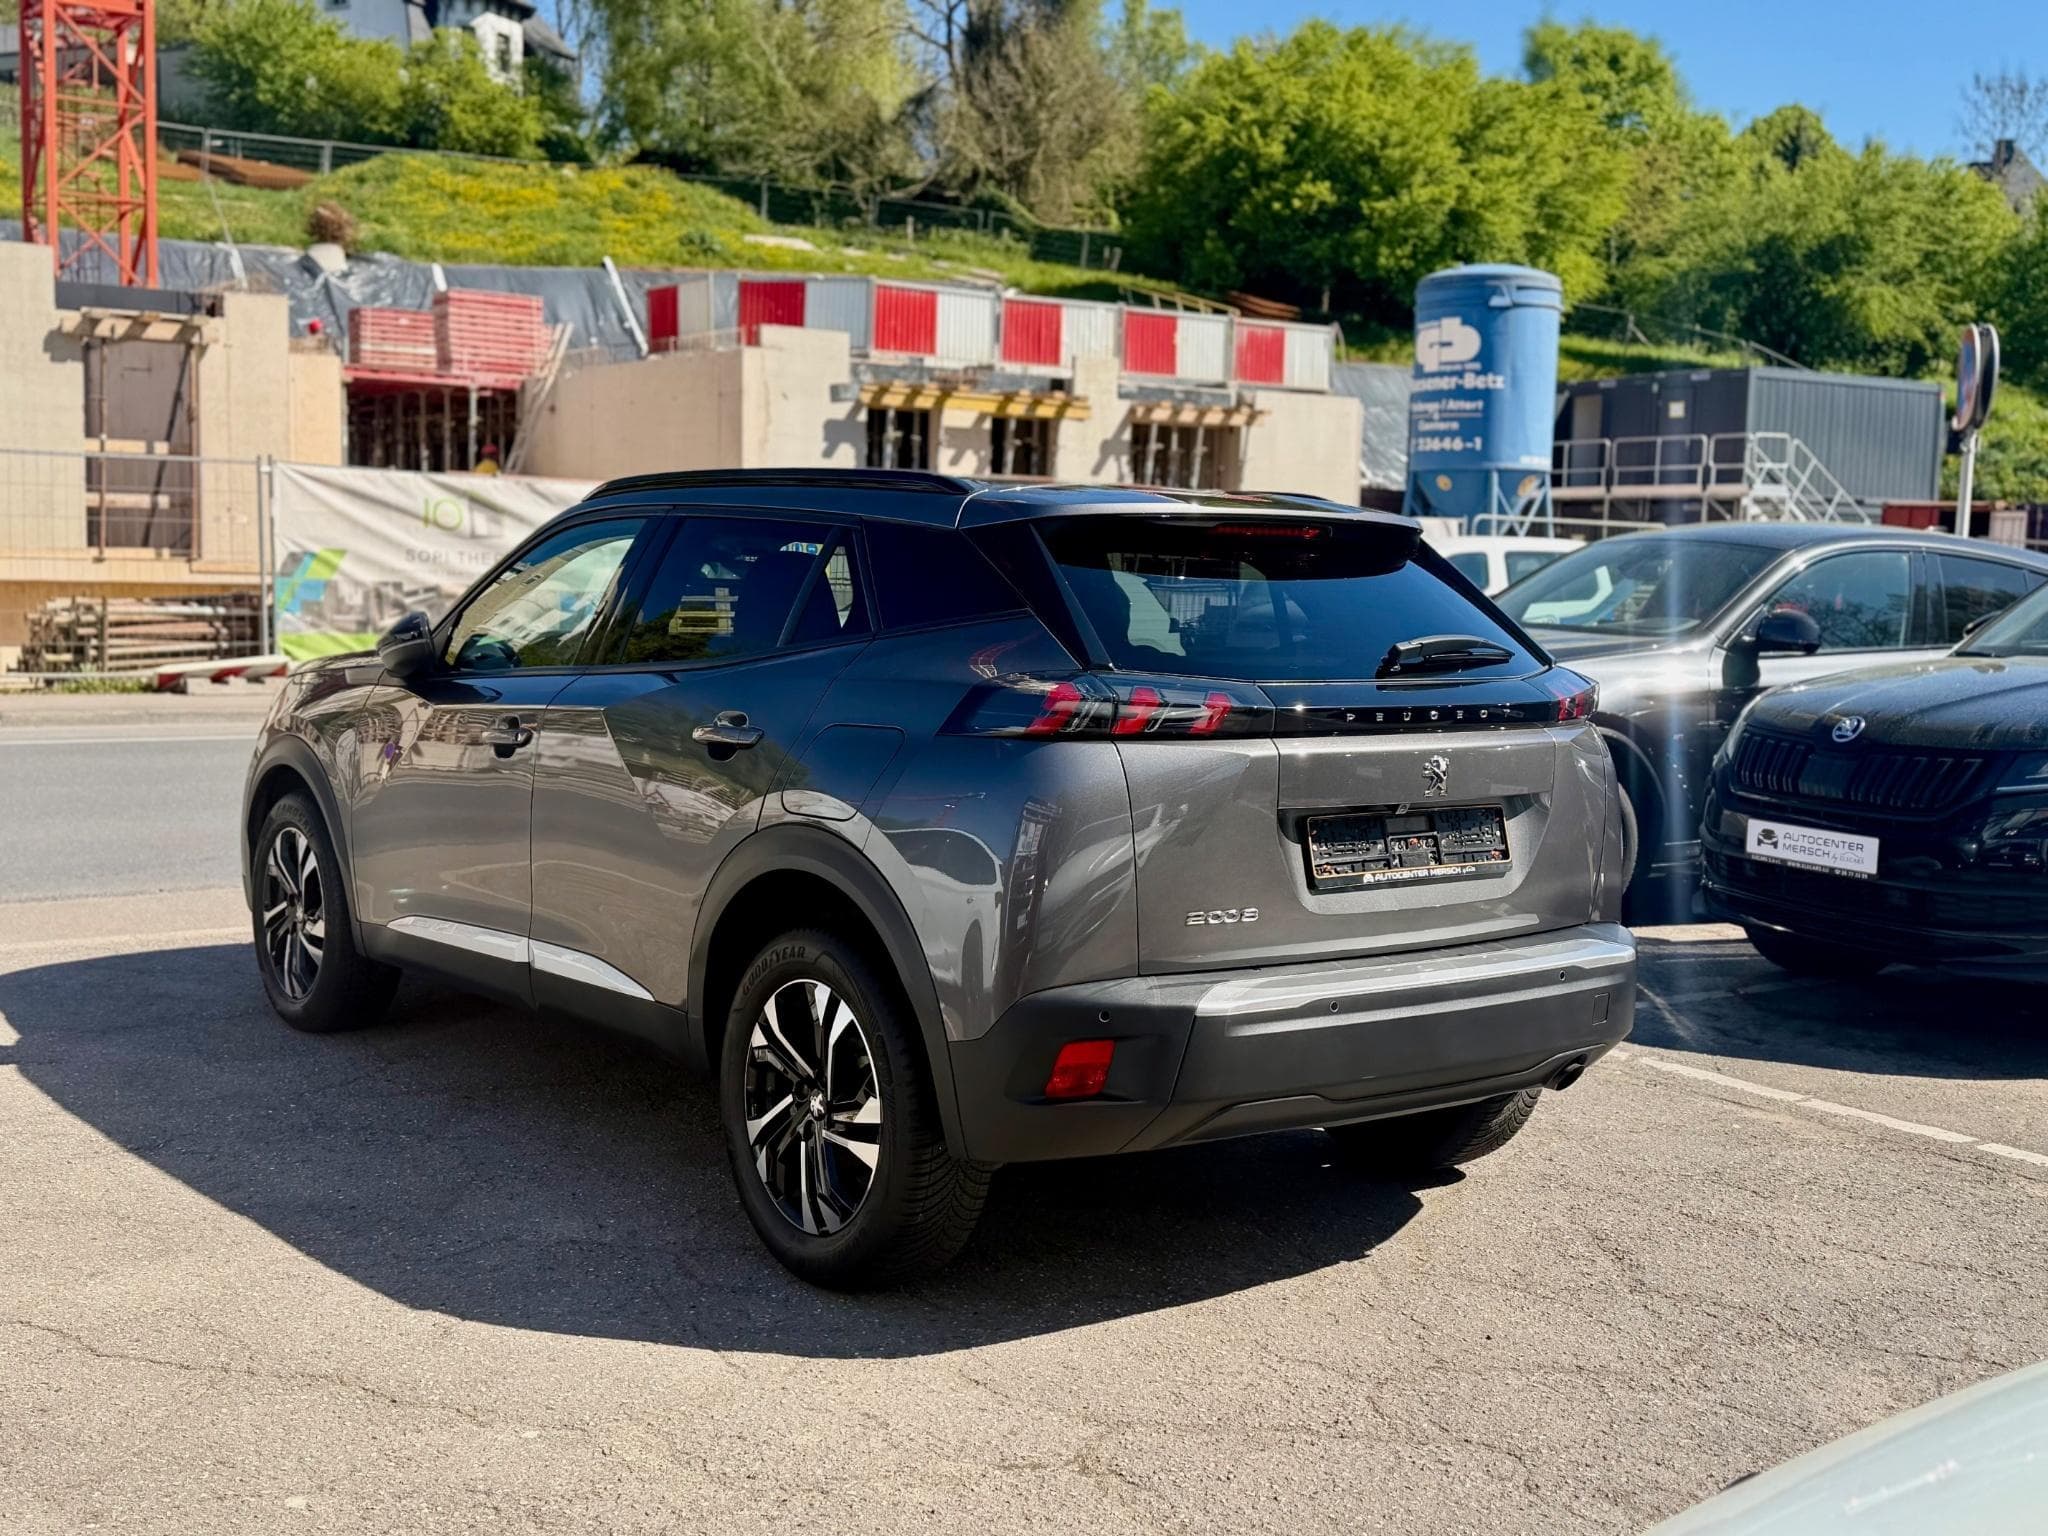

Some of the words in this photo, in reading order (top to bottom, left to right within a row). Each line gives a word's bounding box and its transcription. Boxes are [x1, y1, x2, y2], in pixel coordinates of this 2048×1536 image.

[1783, 832, 1864, 852] AUTOCENTER
[1782, 843, 1830, 859] MERSCH
[1374, 868, 1429, 881] AUTOCENTER
[1430, 865, 1461, 877] MERSCH
[1185, 907, 1259, 926] 2008
